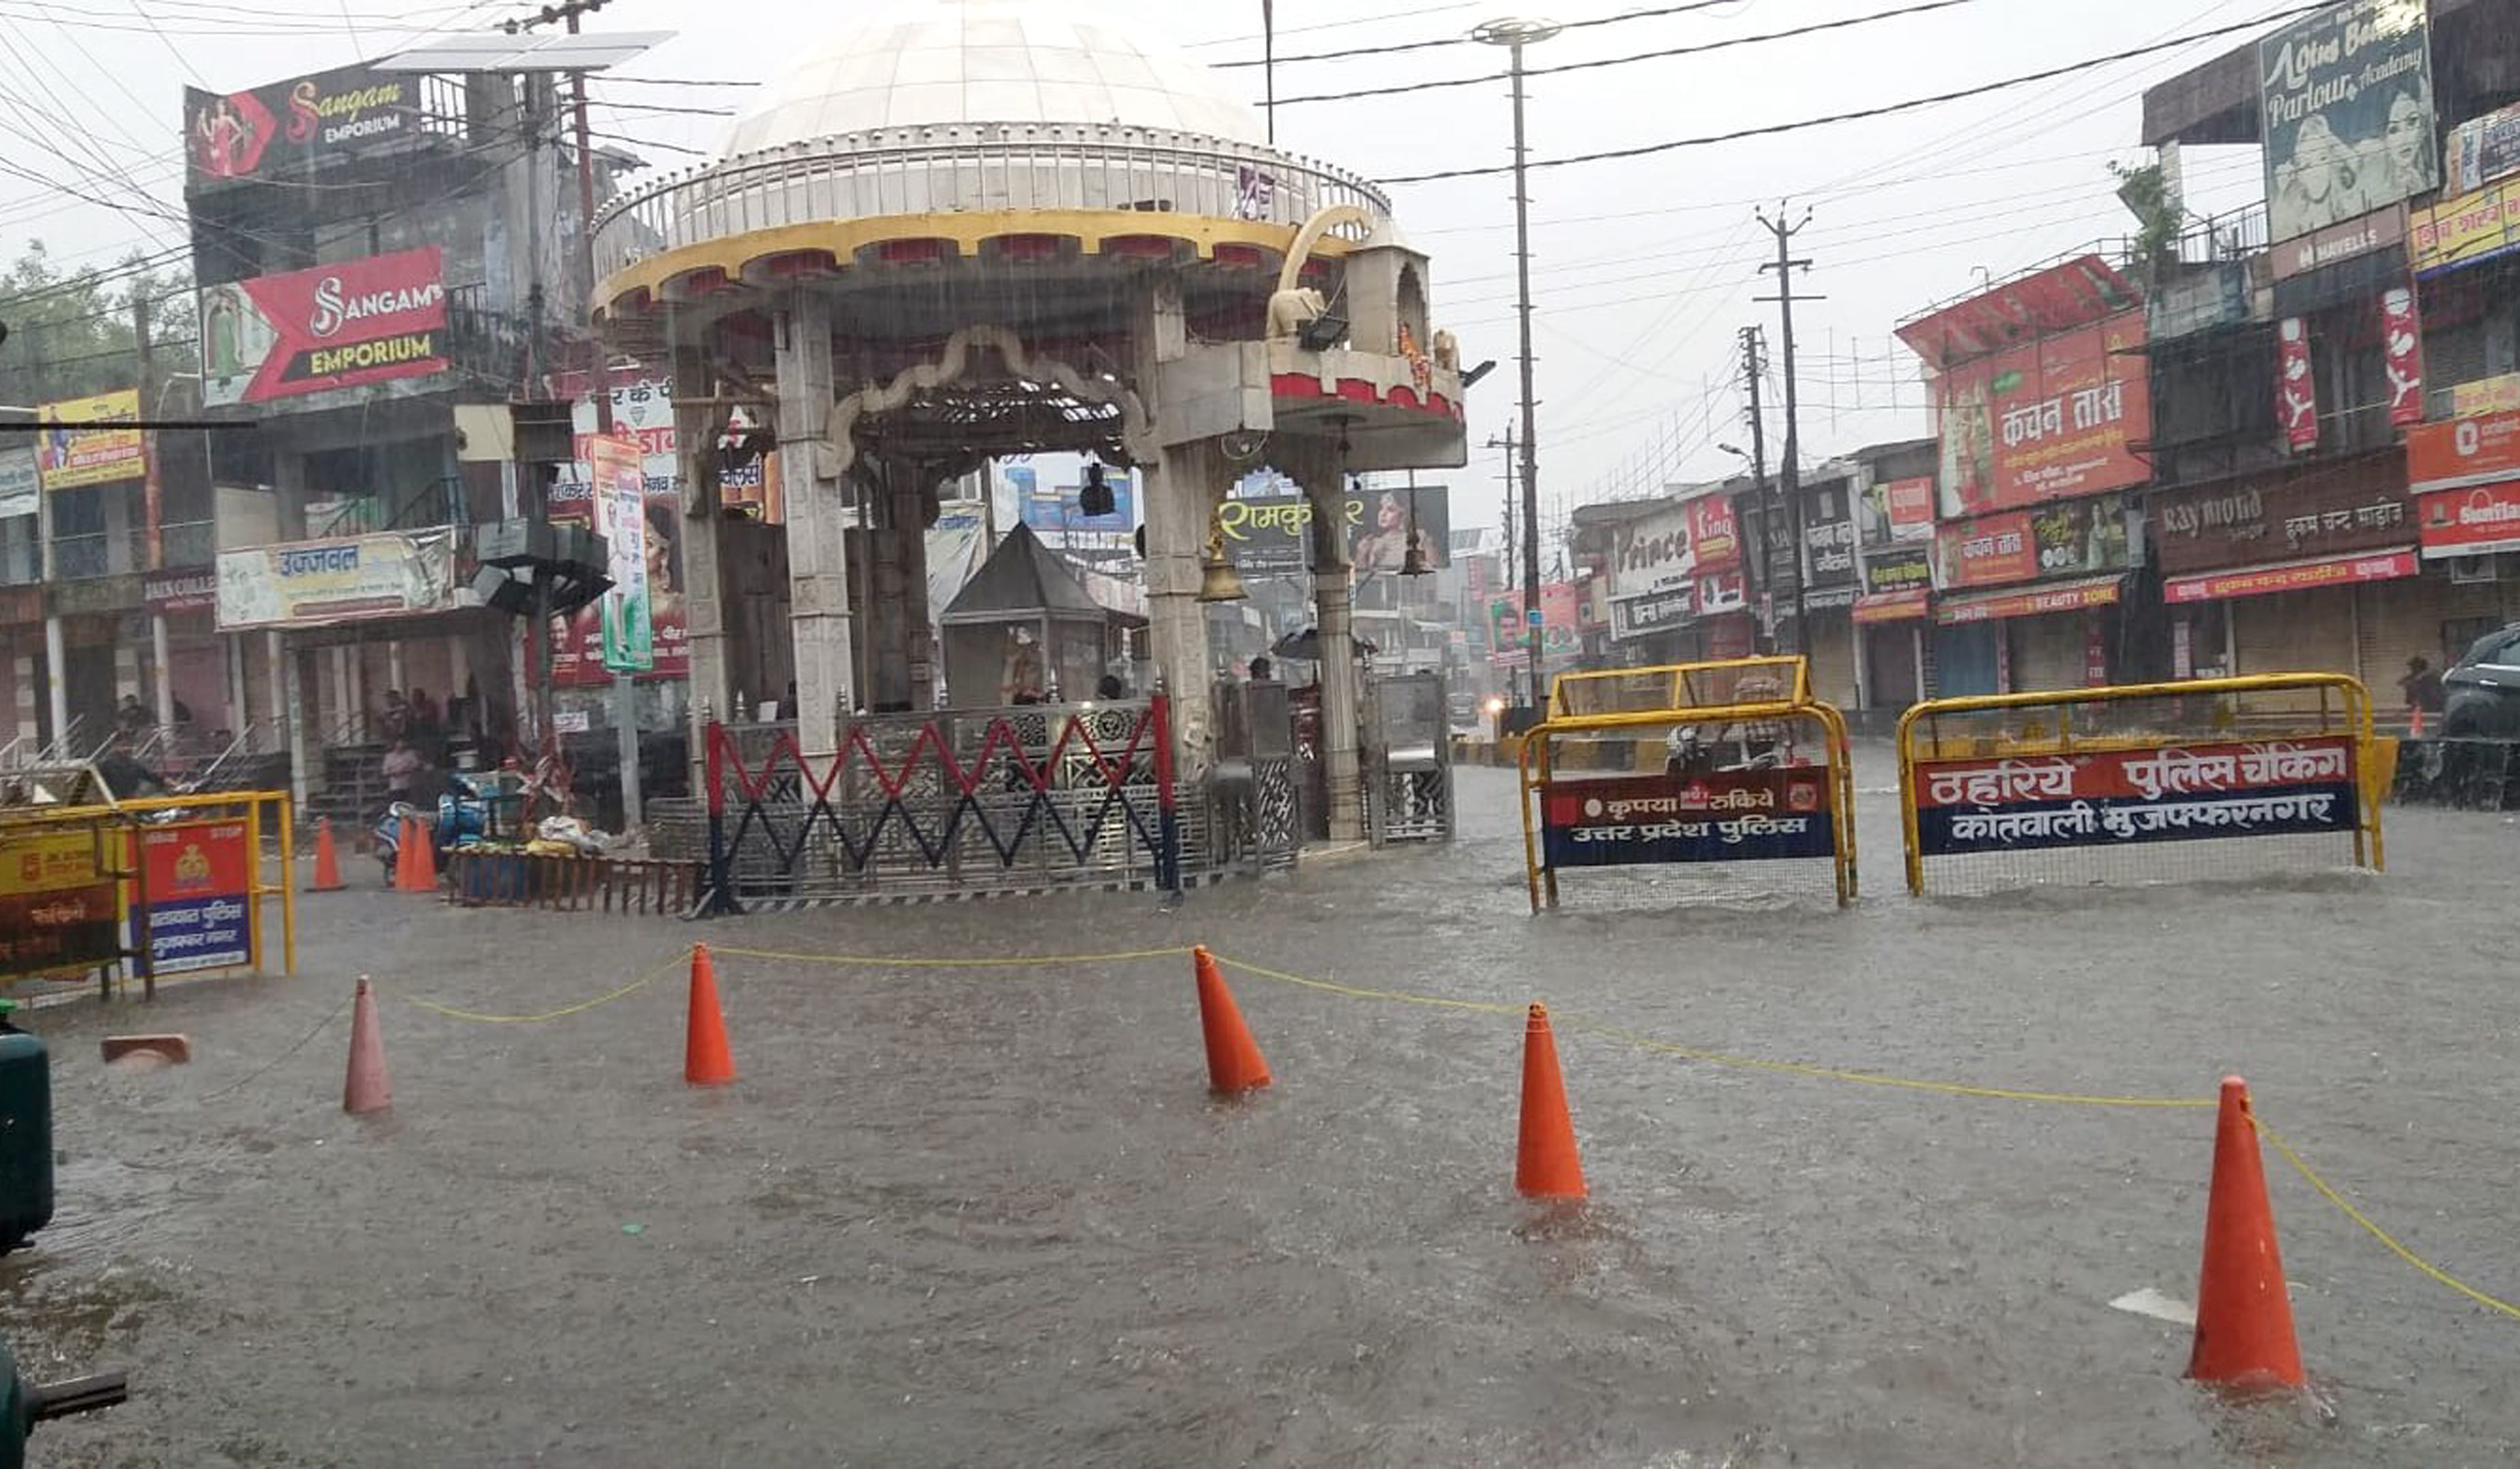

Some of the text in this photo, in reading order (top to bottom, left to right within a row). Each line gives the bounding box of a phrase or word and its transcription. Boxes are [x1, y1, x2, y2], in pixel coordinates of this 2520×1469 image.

[2269, 72, 2353, 128] Parlour
[2358, 48, 2422, 90] Academy
[289, 81, 403, 145] Sangam
[324, 113, 401, 143] EMPORIUM
[311, 334, 431, 374] EMPORIUM
[2001, 379, 2124, 448] कंचन तारा
[2162, 487, 2264, 538] Raymond
[1928, 757, 2075, 806] ठहरिये
[2122, 747, 2236, 800] पुलिस
[1606, 787, 1775, 820] कृपया रुकिये
[1952, 800, 2094, 843] कोतवाली
[1571, 815, 1808, 844] उत्तर प्रदेश पुलिस
[203, 899, 243, 929] पुलिस
